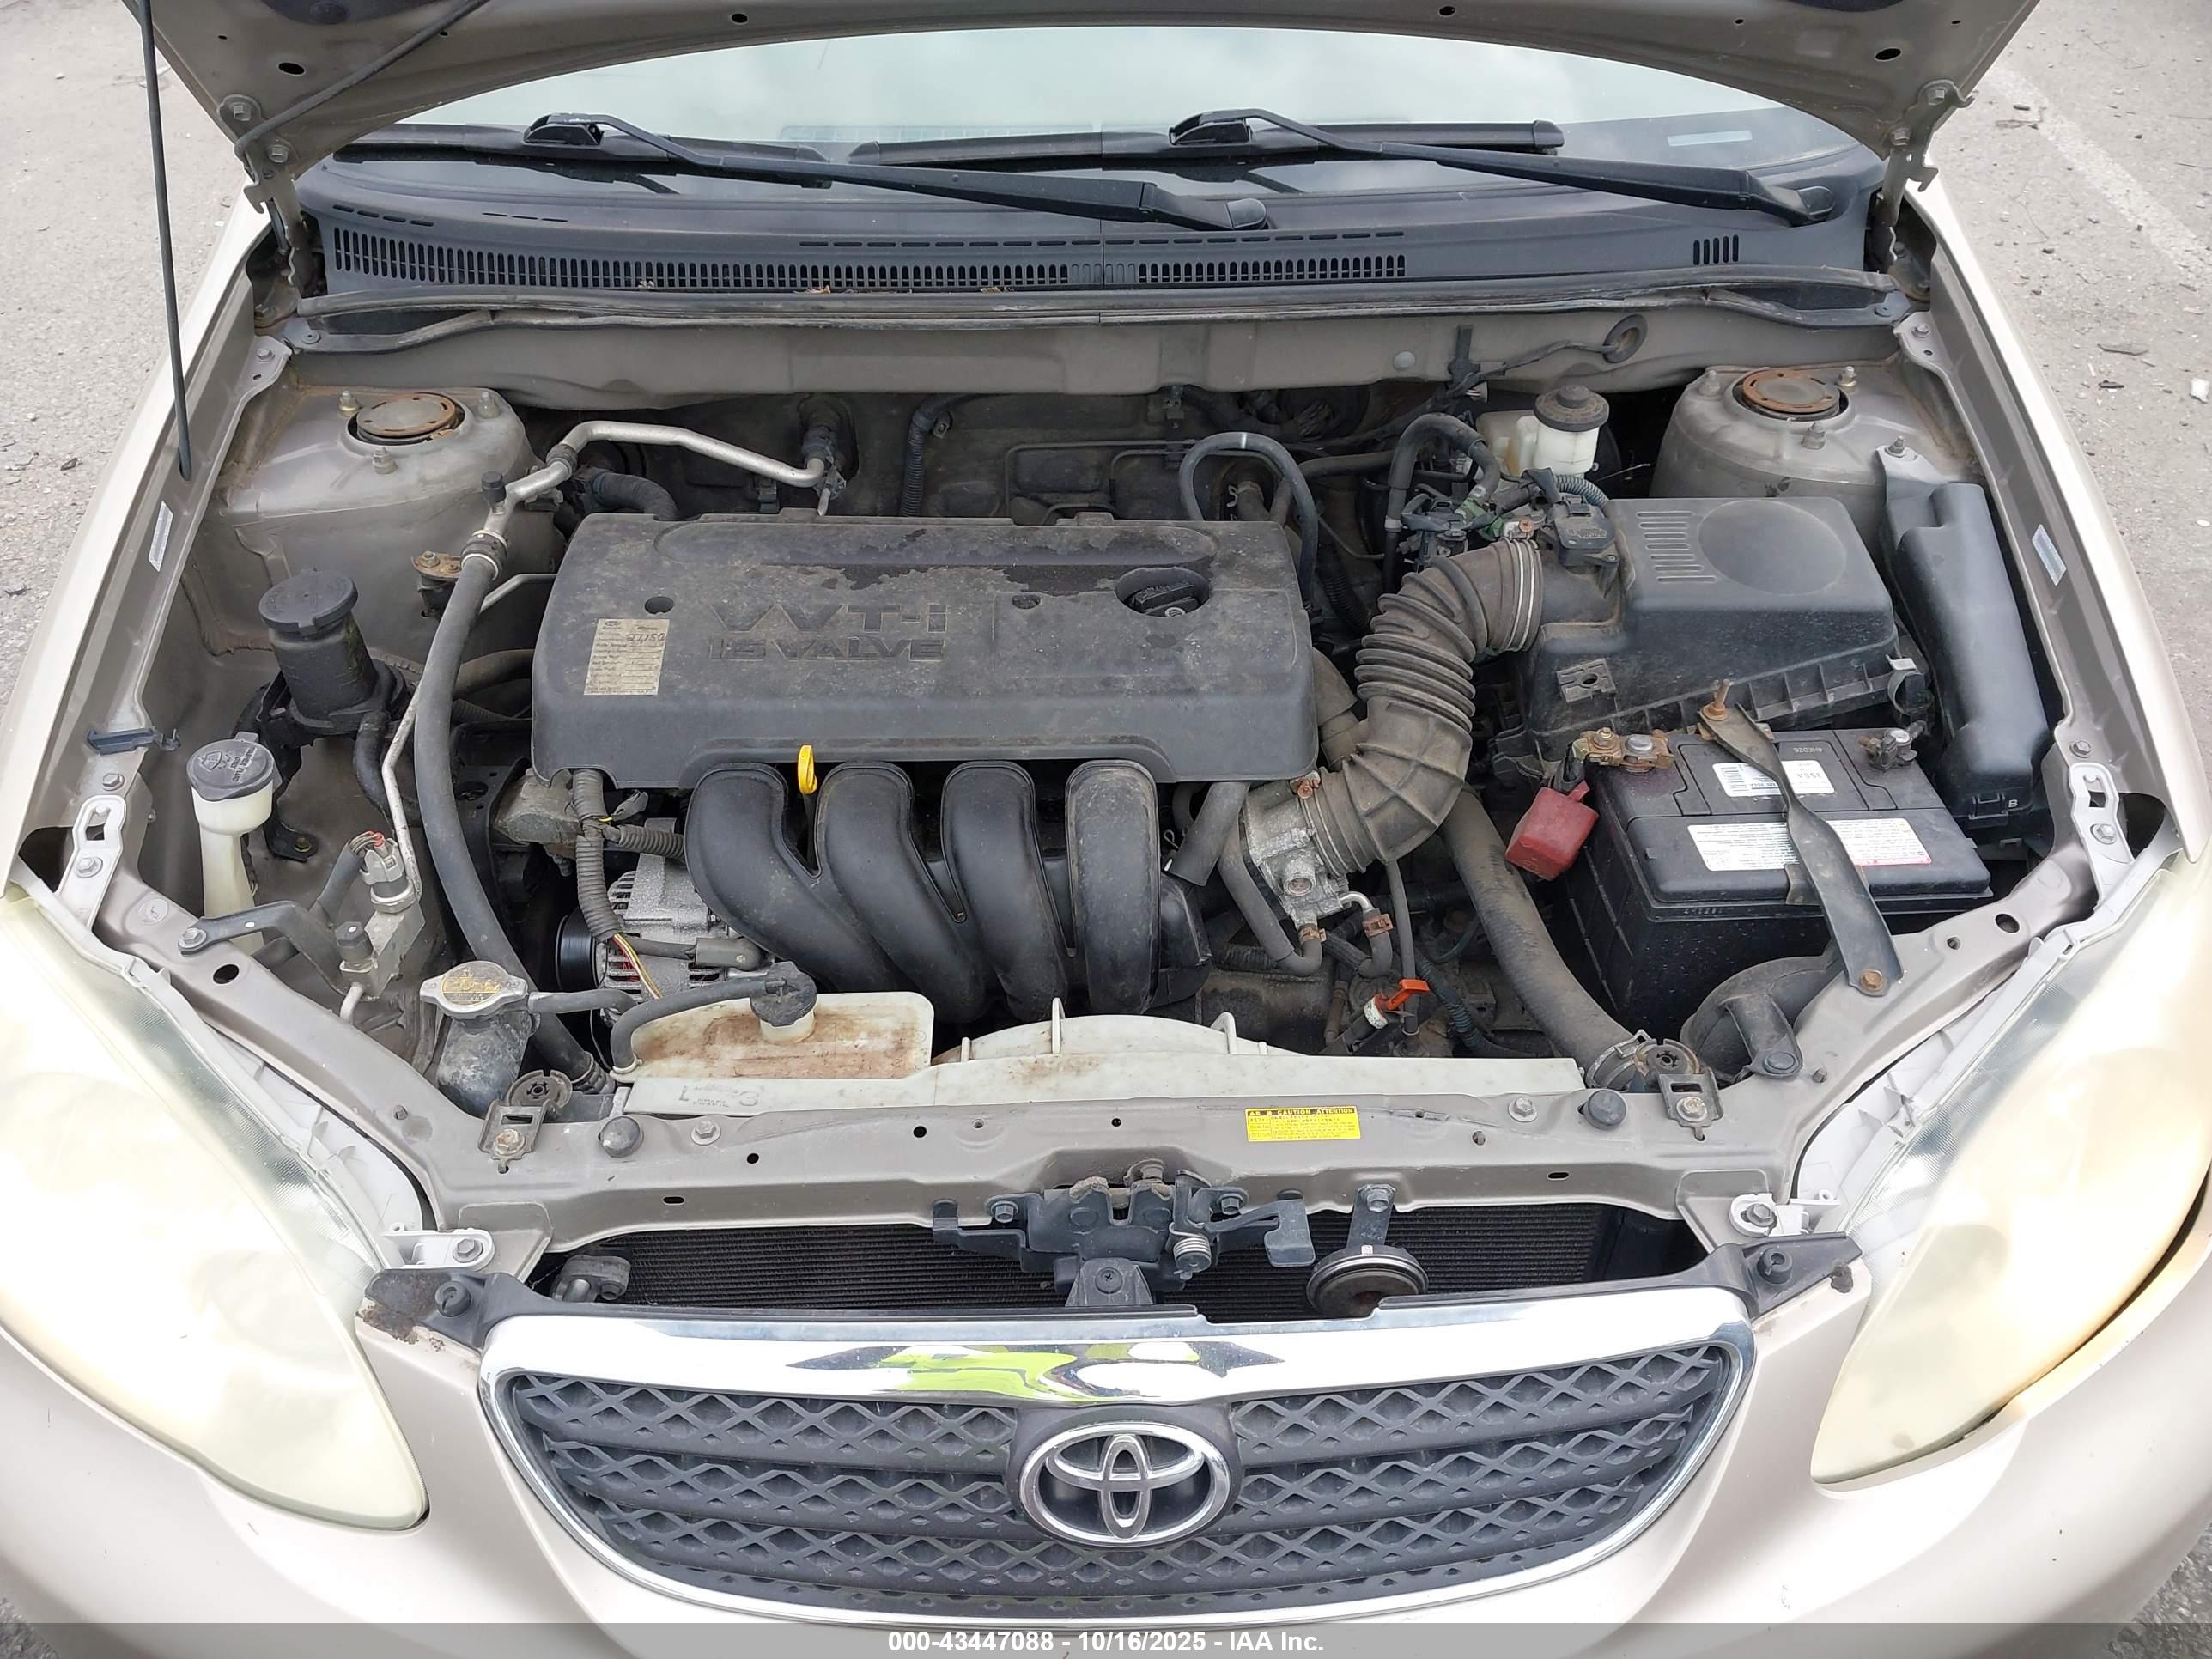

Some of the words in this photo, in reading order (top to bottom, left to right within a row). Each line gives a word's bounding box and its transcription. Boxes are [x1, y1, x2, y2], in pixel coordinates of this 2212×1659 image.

[709, 603, 947, 633] VVT-i
[773, 636, 946, 662] VALVE
[2008, 799, 2019, 808] B
